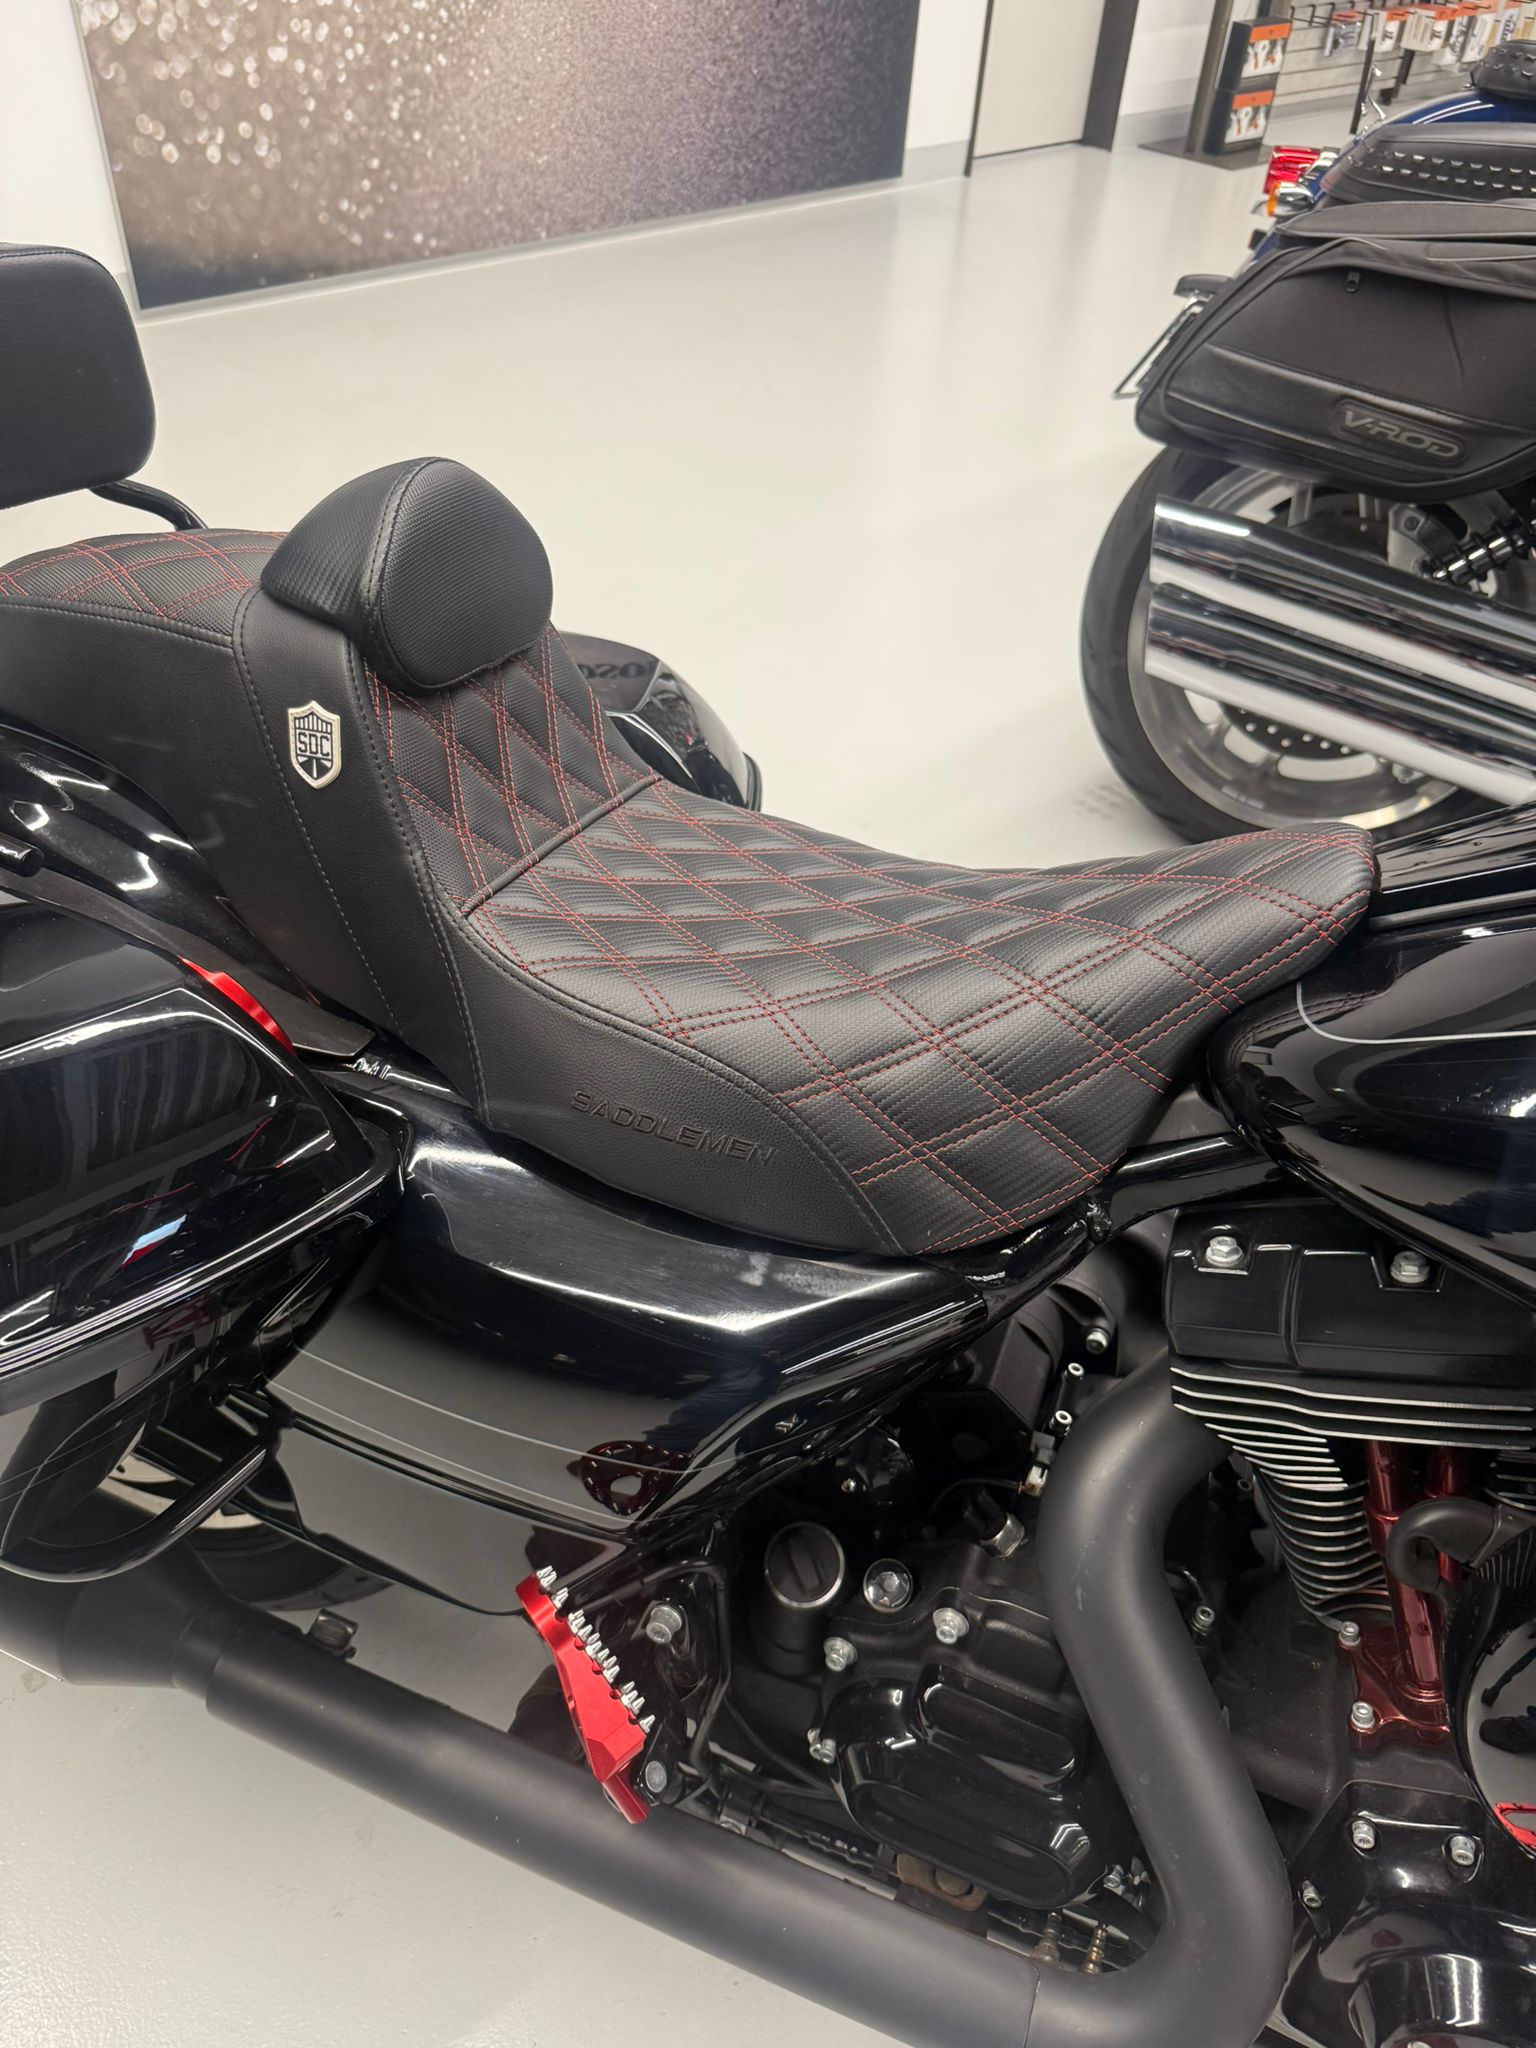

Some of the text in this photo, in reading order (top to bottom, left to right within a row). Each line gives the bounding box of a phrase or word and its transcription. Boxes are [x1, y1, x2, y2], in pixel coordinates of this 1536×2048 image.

[1344, 410, 1459, 457] V-ROD
[297, 731, 330, 757] SDC
[571, 1090, 777, 1166] SADDLEMEN
